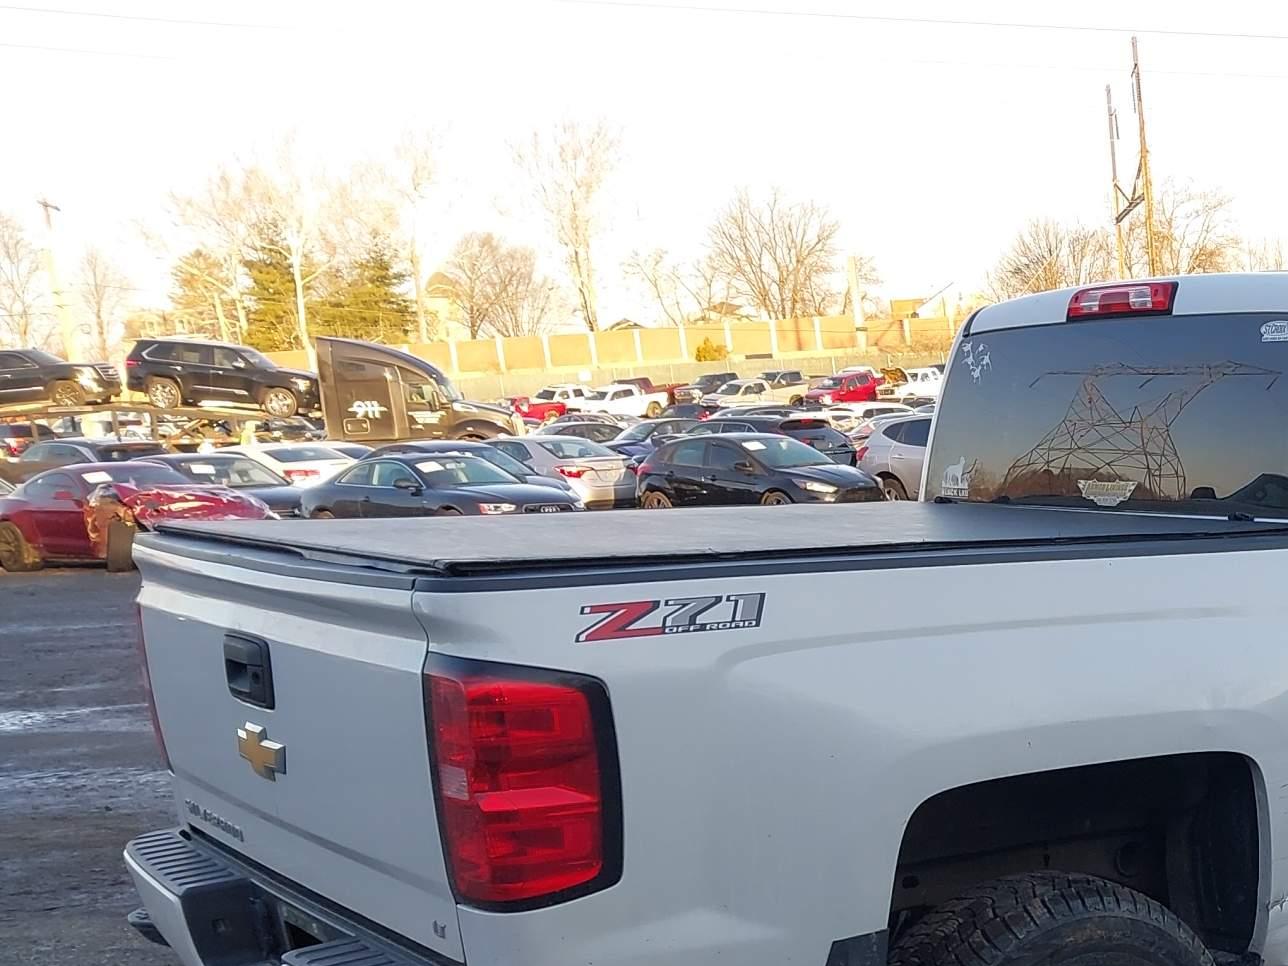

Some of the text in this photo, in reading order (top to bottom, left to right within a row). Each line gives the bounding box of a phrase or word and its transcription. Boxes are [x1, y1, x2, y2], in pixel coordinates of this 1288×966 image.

[574, 592, 767, 643] Z71
[664, 619, 758, 634] OFF ROAD
